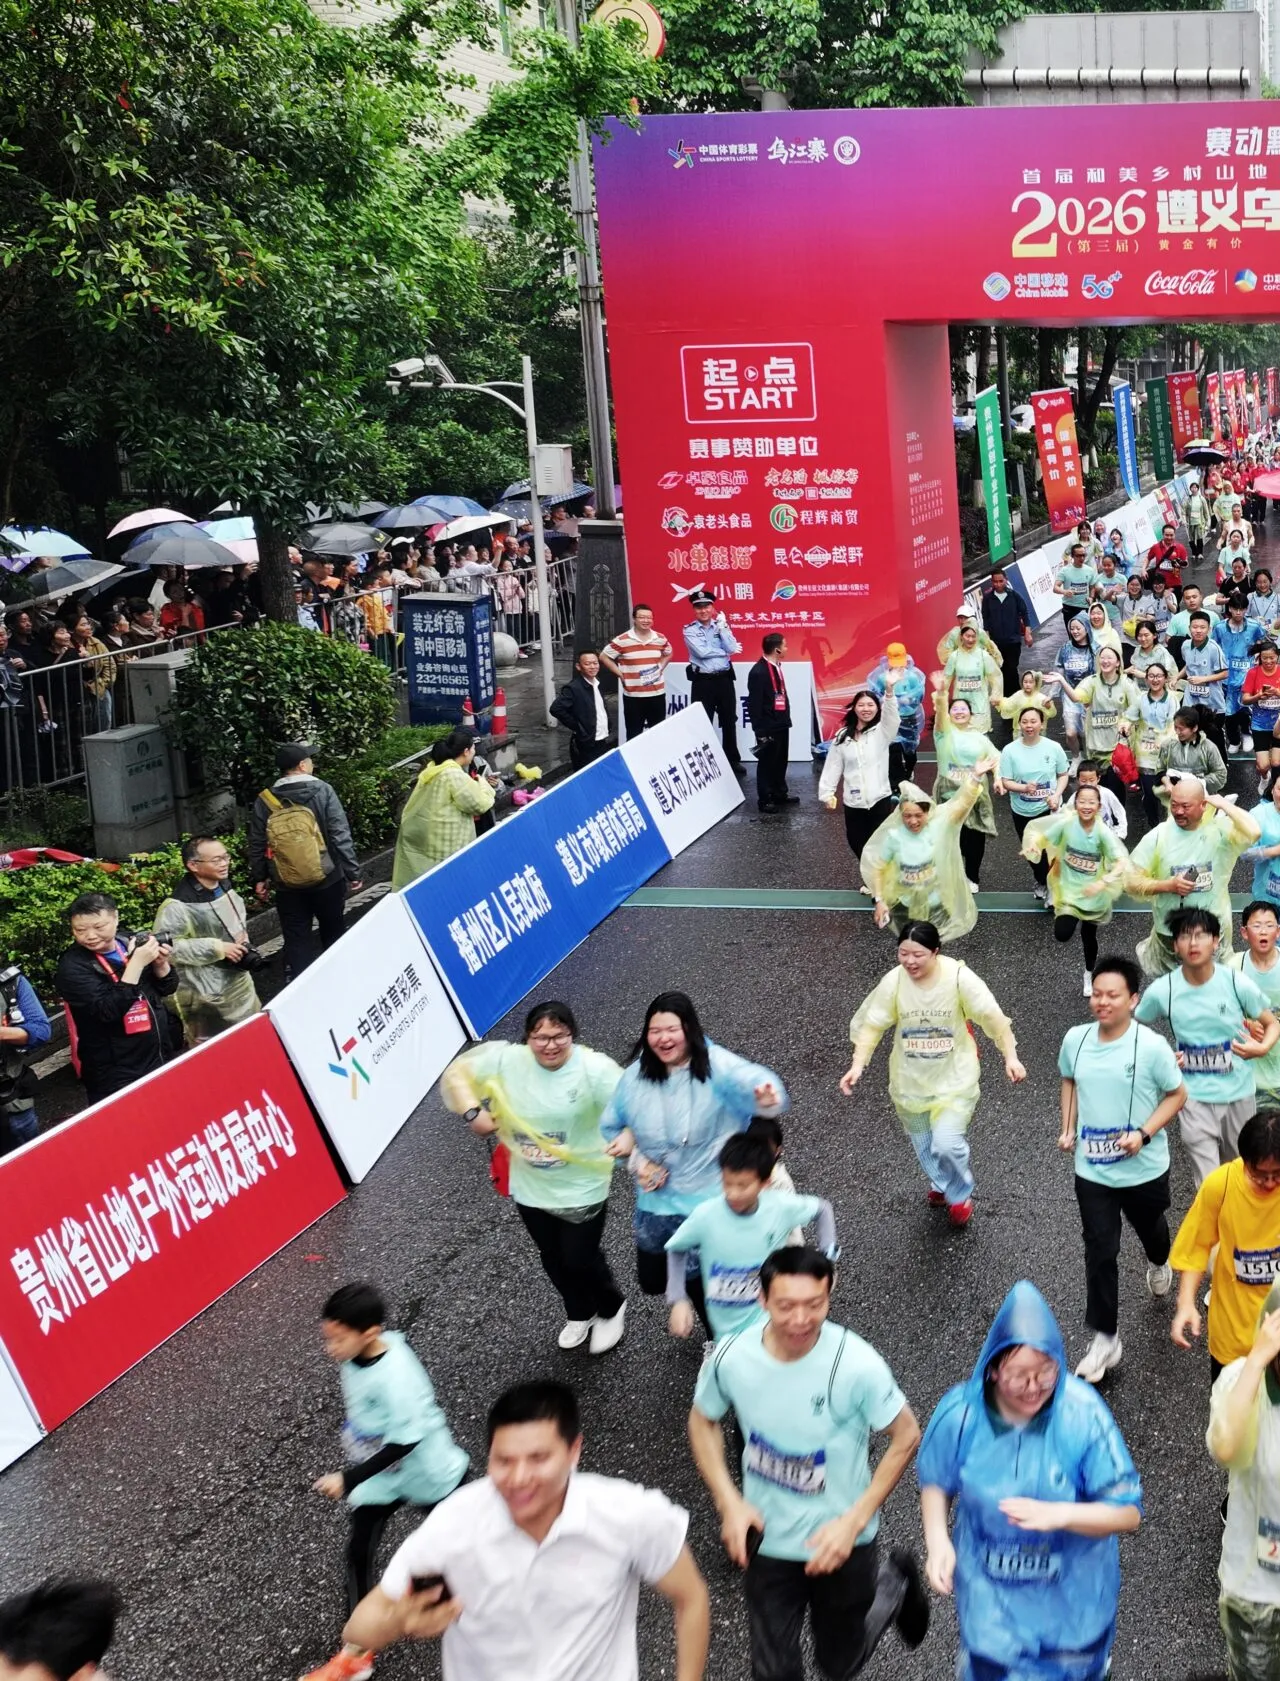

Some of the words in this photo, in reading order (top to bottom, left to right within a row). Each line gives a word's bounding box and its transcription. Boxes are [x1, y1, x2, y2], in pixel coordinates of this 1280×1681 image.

[699, 143, 758, 156] 中国体育彩票
[1012, 189, 1147, 258] 2026
[1158, 237, 1243, 251] 黄金有价
[1014, 272, 1068, 287] 中国移动
[1015, 288, 1039, 298] China
[1040, 288, 1069, 298] Mobile
[703, 356, 796, 387] 起点
[703, 387, 798, 411] START
[688, 436, 819, 459] 赛事赞助单位
[693, 513, 752, 530] 袁老头食品
[800, 509, 859, 526] 程辉商贸
[713, 583, 754, 601] 小鹏
[414, 637, 467, 658] 到中国移动
[415, 674, 470, 686] 23216565
[648, 741, 722, 817] 遵义市人民政府
[554, 790, 648, 888] 遵义市教育体育局
[447, 864, 552, 976] 播州区人民政府
[357, 963, 423, 1044] 中国体育彩票
[372, 1039, 390, 1065] CHINA
[389, 1016, 411, 1046] SPORTS
[407, 993, 433, 1024] LOTTERY
[905, 1039, 918, 1049] JH
[920, 1038, 953, 1049] 10003
[1086, 1140, 1122, 1156] 1186
[9, 1088, 297, 1336] 贵州省山地户外运动发展中心
